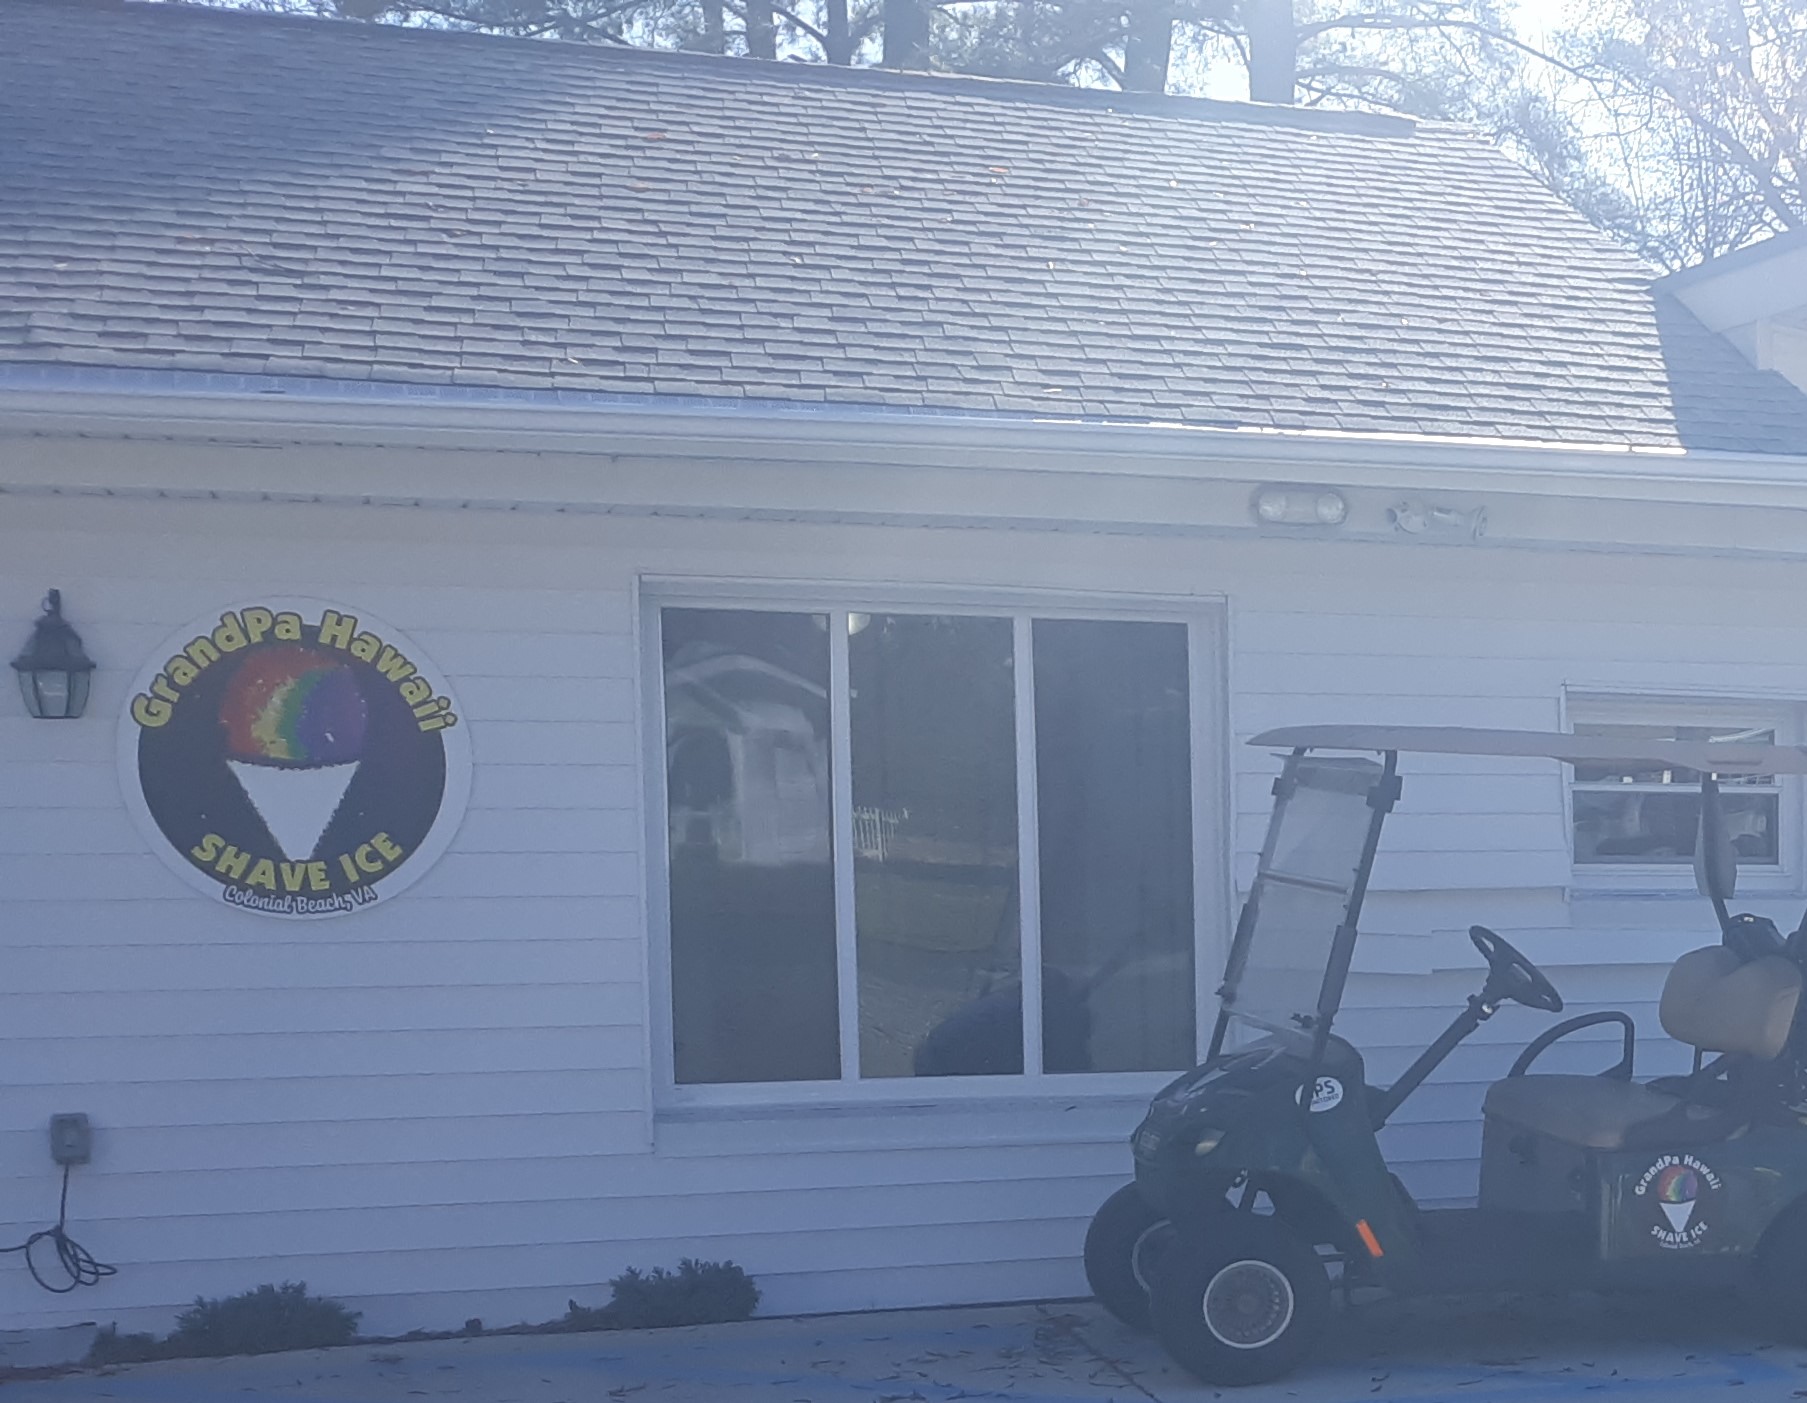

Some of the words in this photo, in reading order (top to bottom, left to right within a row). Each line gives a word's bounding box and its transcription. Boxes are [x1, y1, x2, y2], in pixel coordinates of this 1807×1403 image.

[132, 607, 301, 728] GrandPa
[319, 610, 457, 732] Hawaii
[191, 834, 330, 891] SHAVE
[339, 832, 403, 883] ICE
[225, 886, 294, 913] Colonial
[351, 886, 376, 902] VA
[1634, 1155, 1680, 1195] GrandPa
[1684, 1154, 1721, 1190] Hawaii
[1651, 1225, 1688, 1242] SHAVE
[1691, 1221, 1708, 1238] ICE
